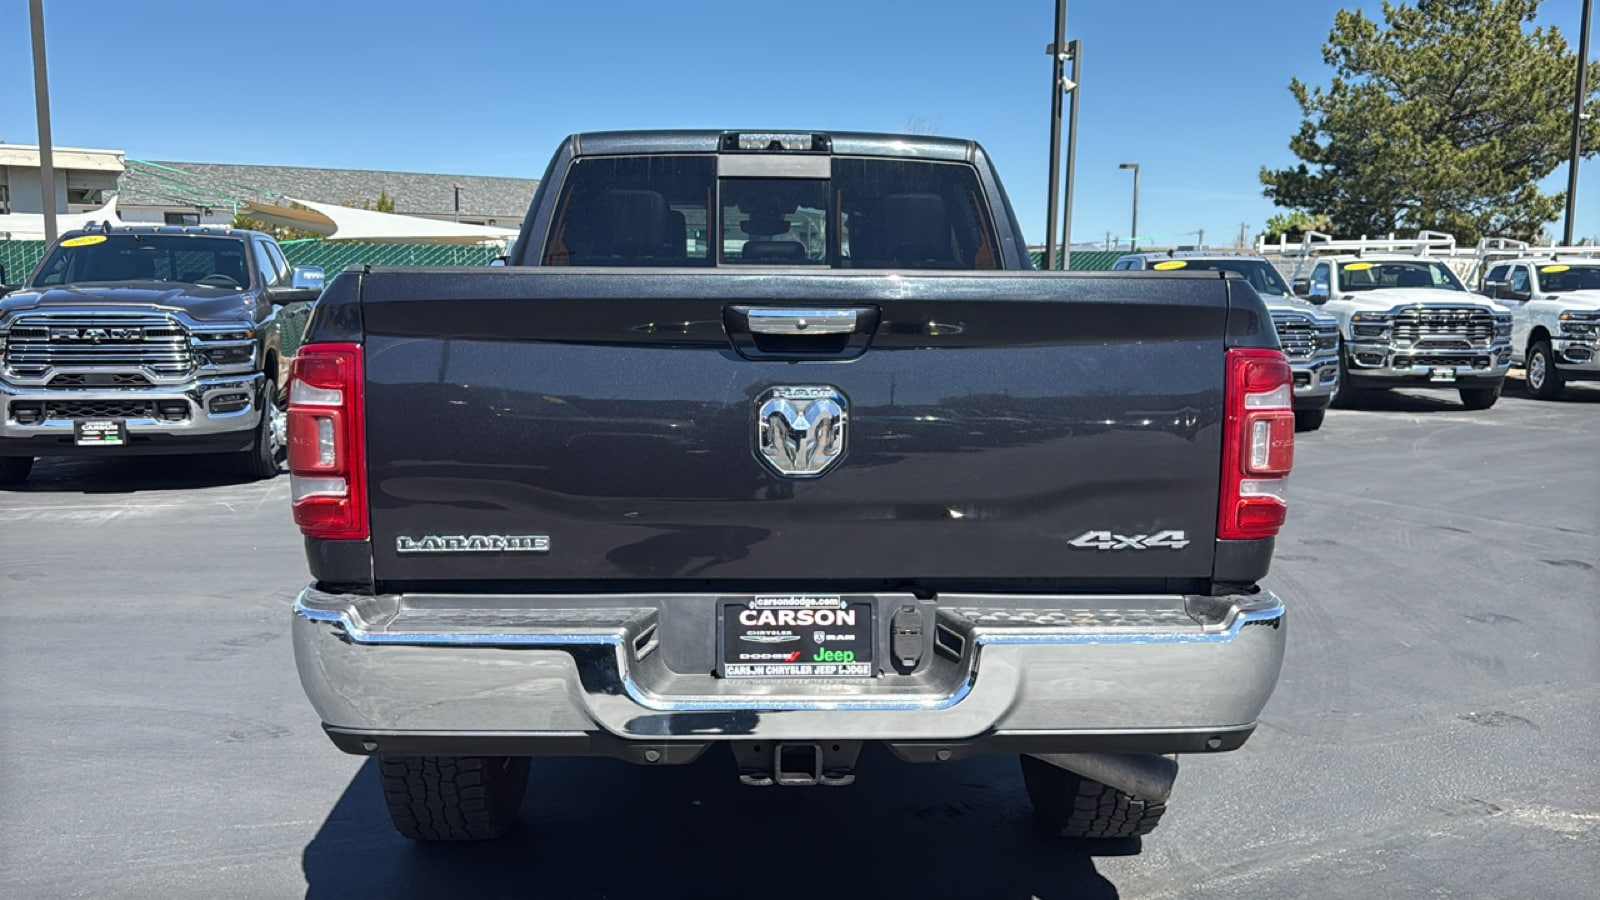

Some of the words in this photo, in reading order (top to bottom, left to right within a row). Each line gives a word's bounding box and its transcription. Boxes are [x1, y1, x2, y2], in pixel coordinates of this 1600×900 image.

[50, 328, 140, 340] RAM
[397, 535, 550, 552] LARAMIE
[757, 597, 839, 608] carsondodge.com
[739, 609, 856, 626] CARSON
[813, 647, 855, 663] Jeep
[766, 665, 812, 675] CHRYSLER
[814, 665, 837, 675] JEEP
